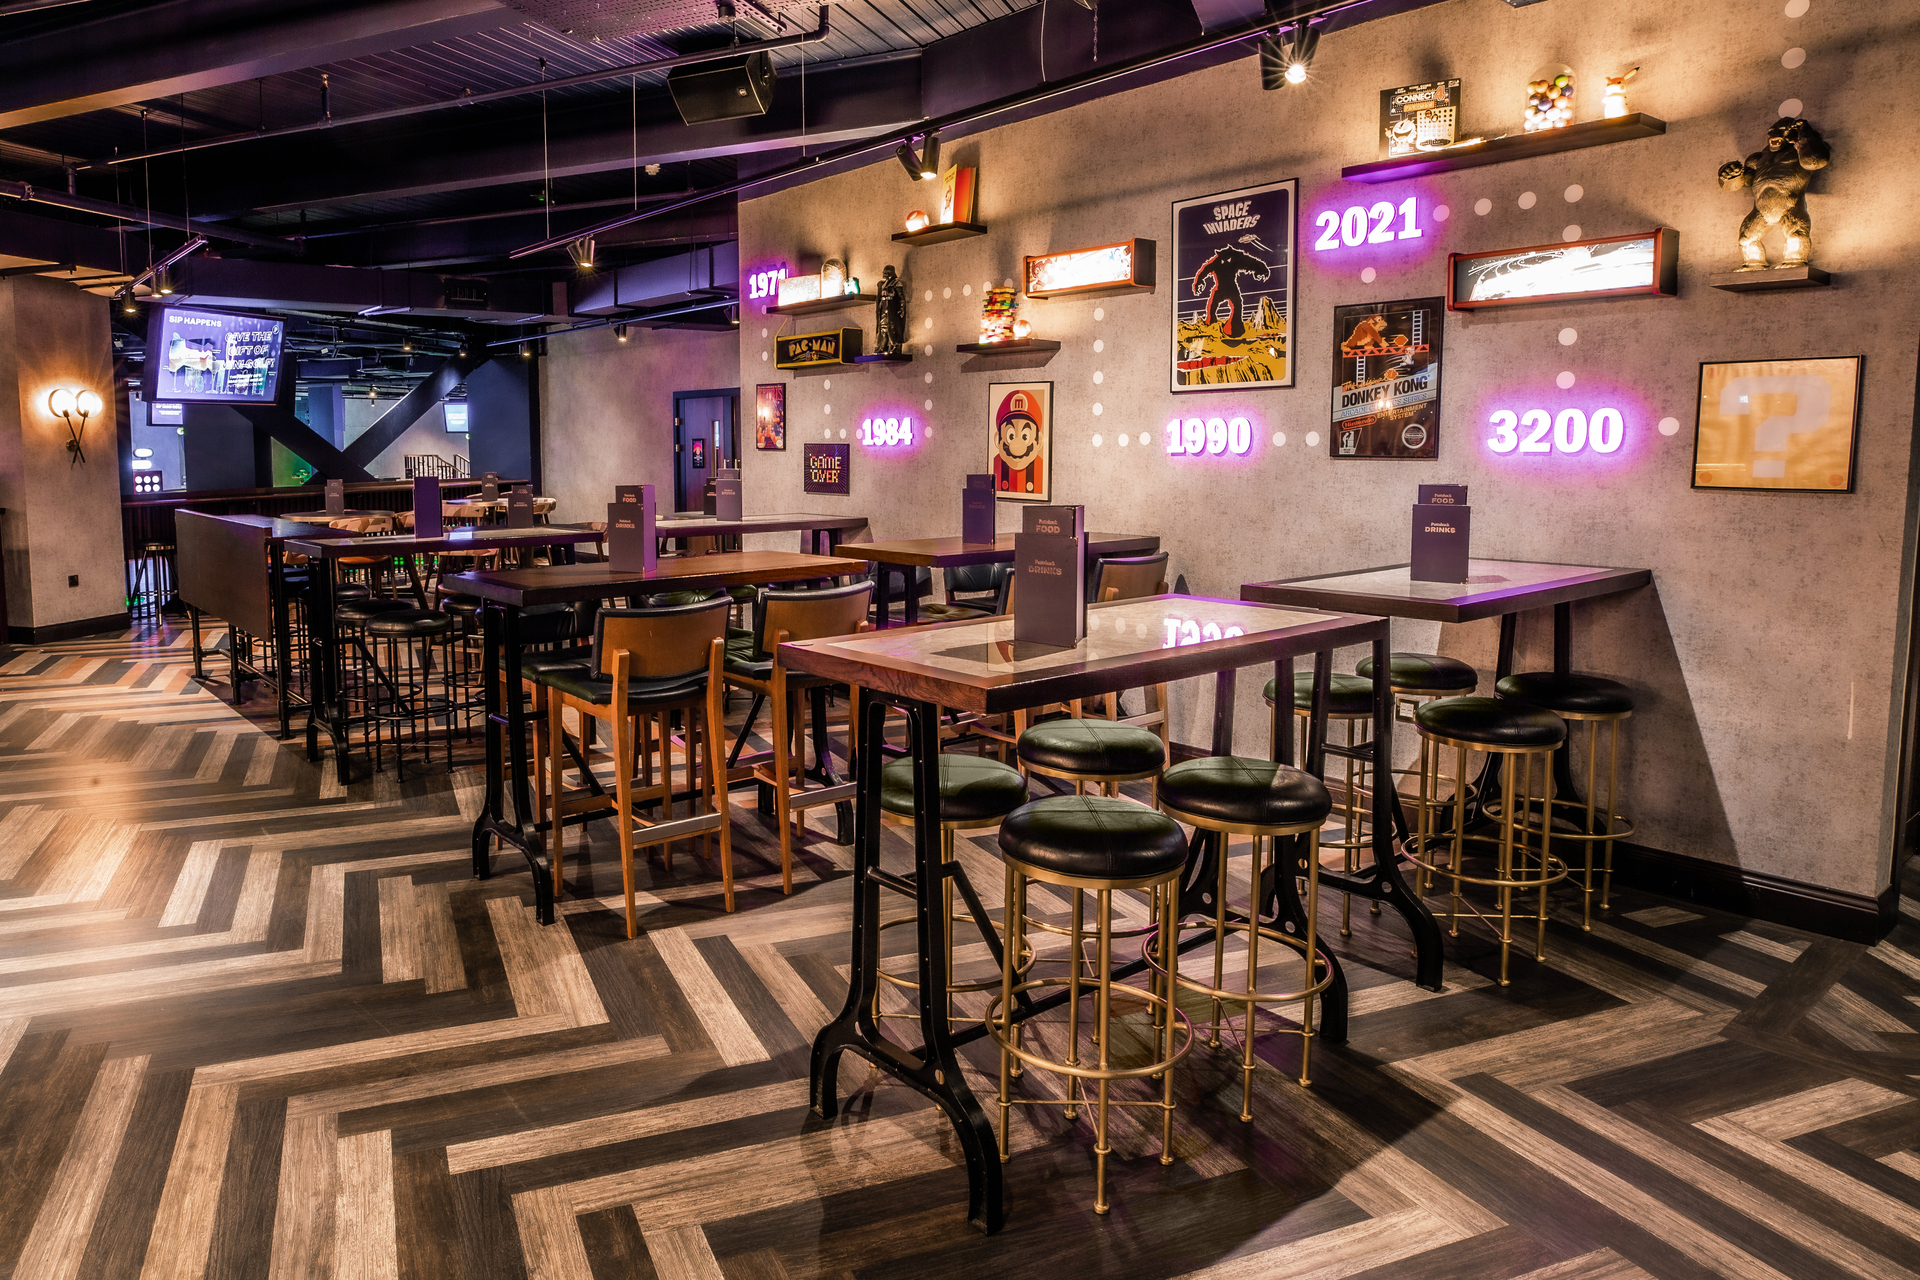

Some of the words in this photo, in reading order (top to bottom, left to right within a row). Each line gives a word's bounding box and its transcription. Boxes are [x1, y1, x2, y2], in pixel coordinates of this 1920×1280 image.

[1396, 91, 1435, 104] CONNECT
[1435, 85, 1446, 101] 4
[1213, 200, 1252, 221] SPACE
[1203, 214, 1261, 235] INVADERS
[1315, 197, 1423, 251] 2021
[169, 315, 183, 324] SIP
[184, 317, 222, 327] HAPPENS
[252, 331, 273, 341] THE
[1342, 384, 1390, 409] DONKEY
[1394, 375, 1428, 397] KONG
[1341, 405, 1368, 418] ARCADE
[1402, 393, 1428, 404] SERIES
[1377, 403, 1428, 419] ENTERTAINMENT
[1344, 416, 1375, 428] Nintendo
[1390, 411, 1414, 421] SYSTEM
[862, 417, 913, 446] 1984
[1166, 417, 1252, 455] 1990
[1487, 408, 1624, 455] 3200
[810, 454, 842, 469] GAME
[810, 470, 840, 483] OVER
[1035, 524, 1060, 533] FOOD
[1028, 565, 1062, 576] DRINKS
